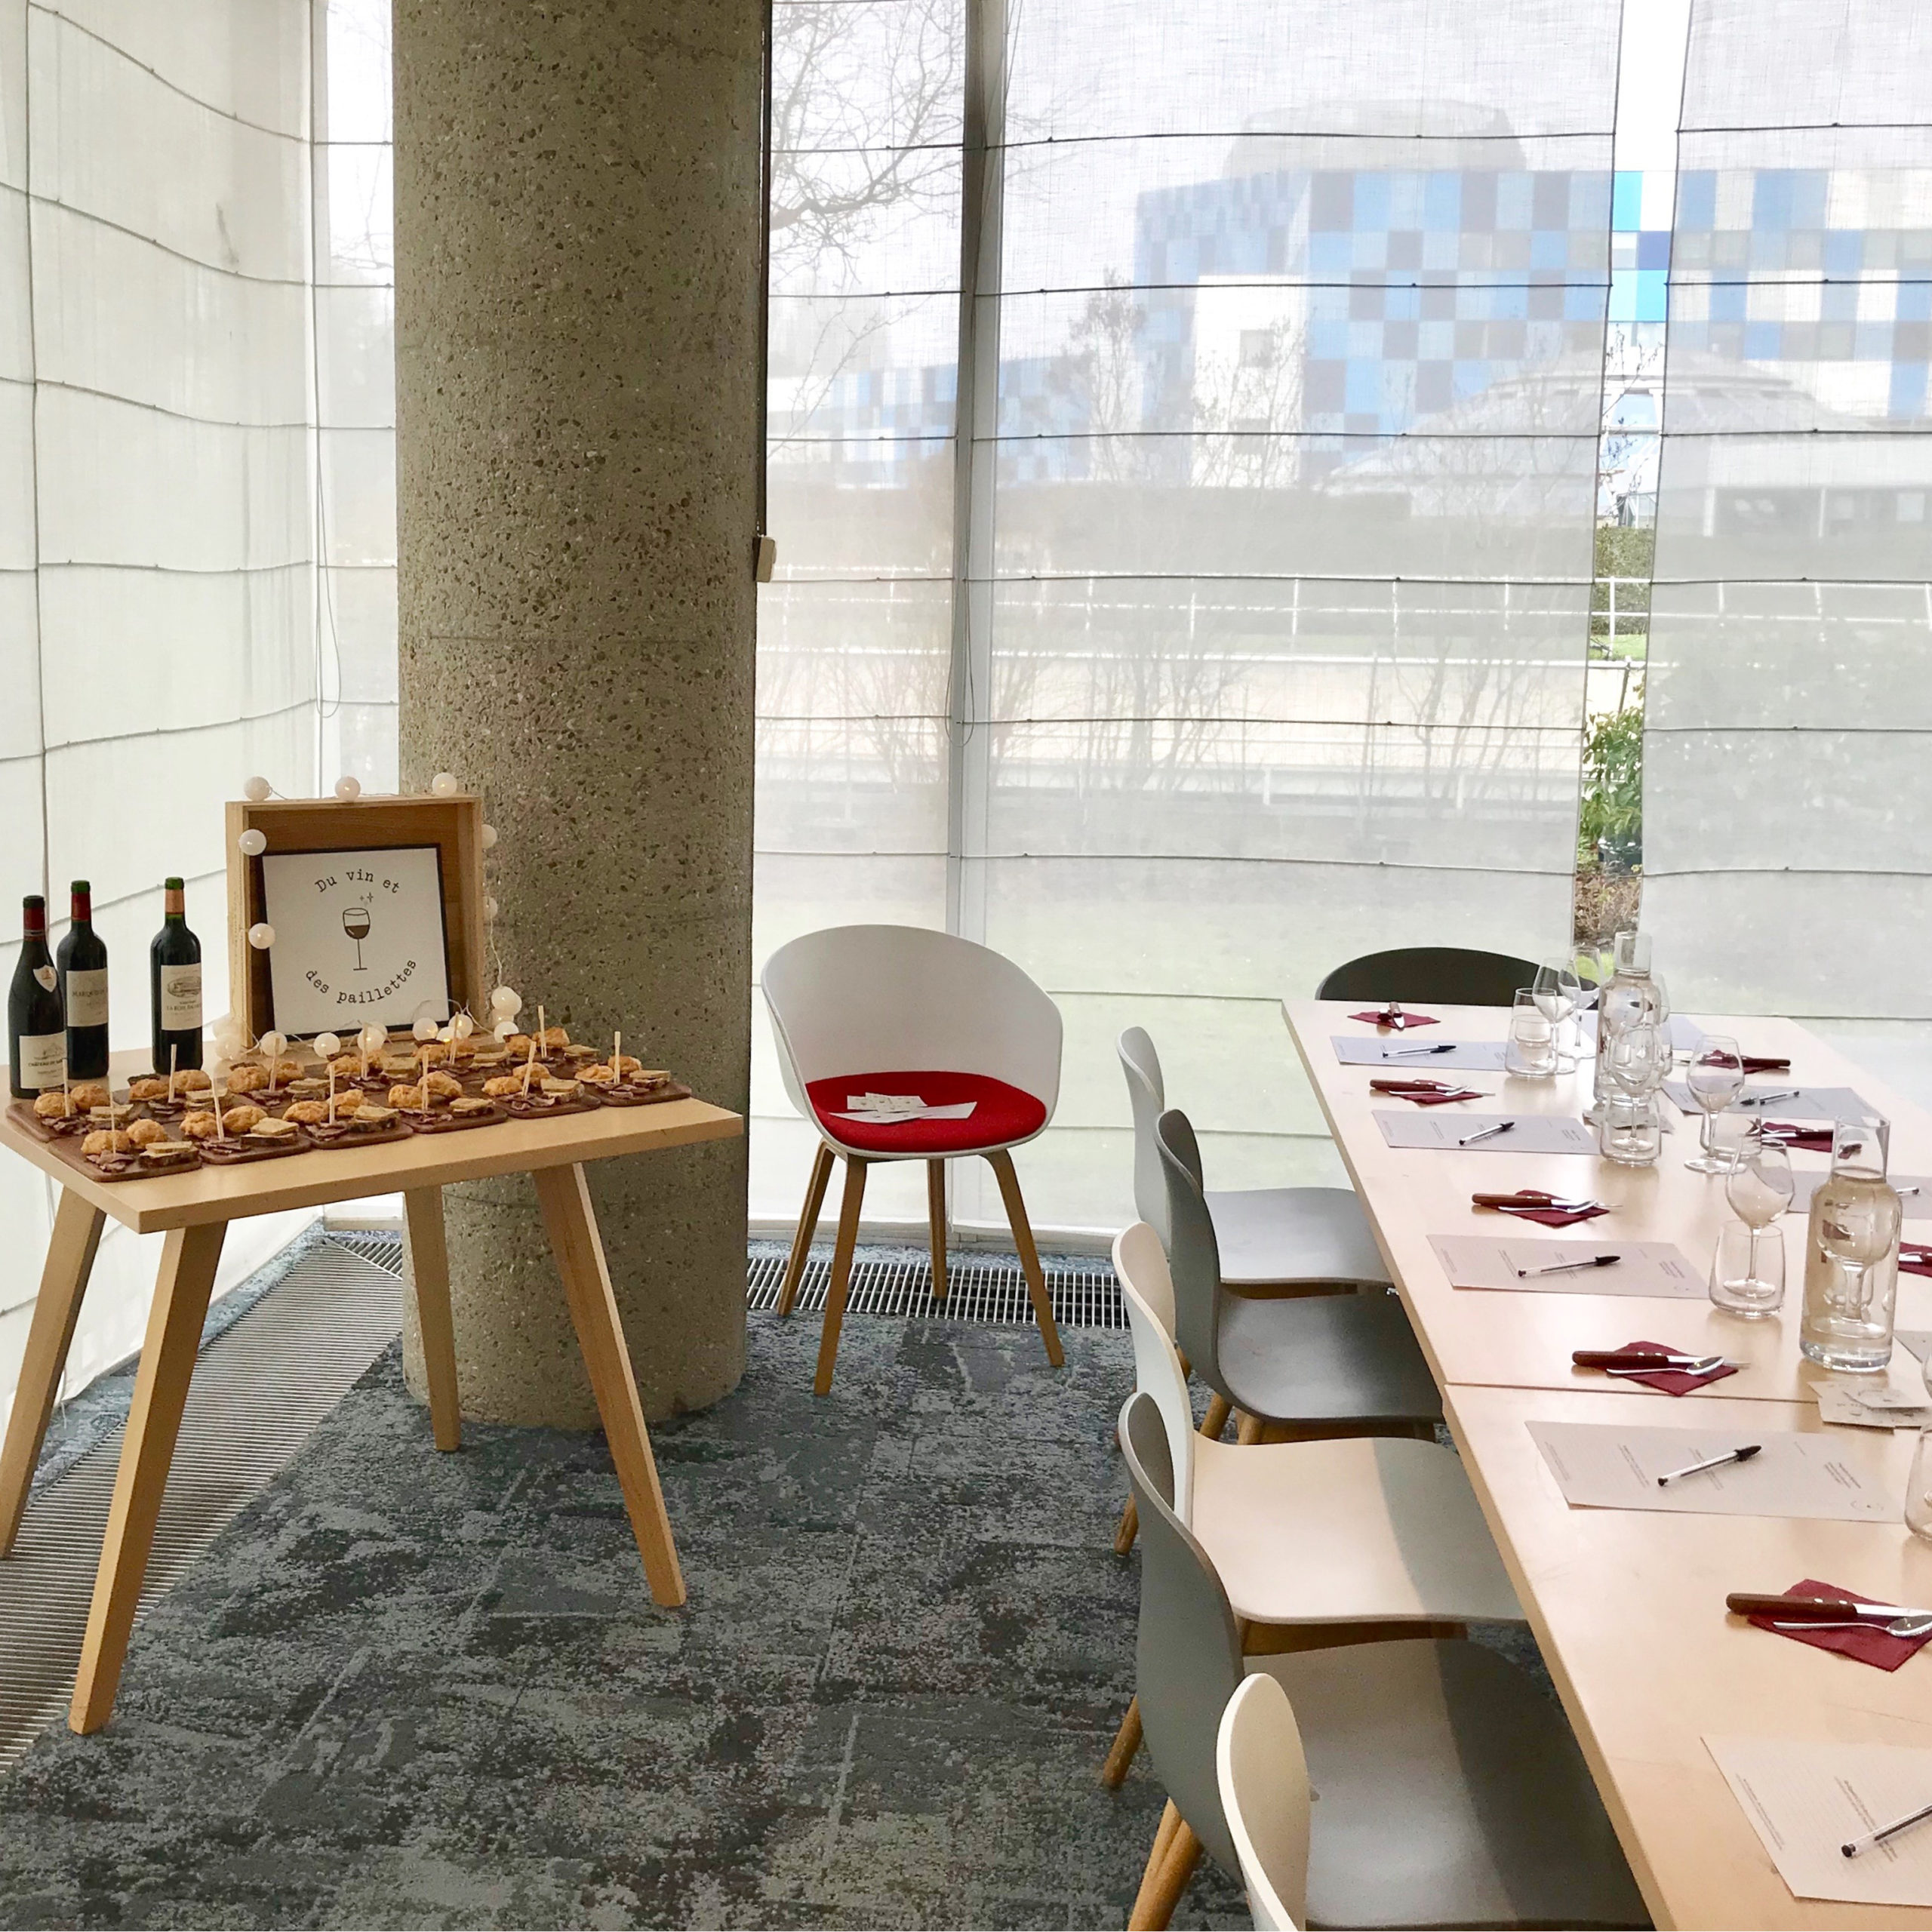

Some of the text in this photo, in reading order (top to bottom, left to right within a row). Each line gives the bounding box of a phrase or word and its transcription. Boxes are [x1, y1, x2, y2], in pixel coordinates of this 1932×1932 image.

[315, 869, 401, 894] Du vin et
[306, 959, 417, 1004] des paillettes
